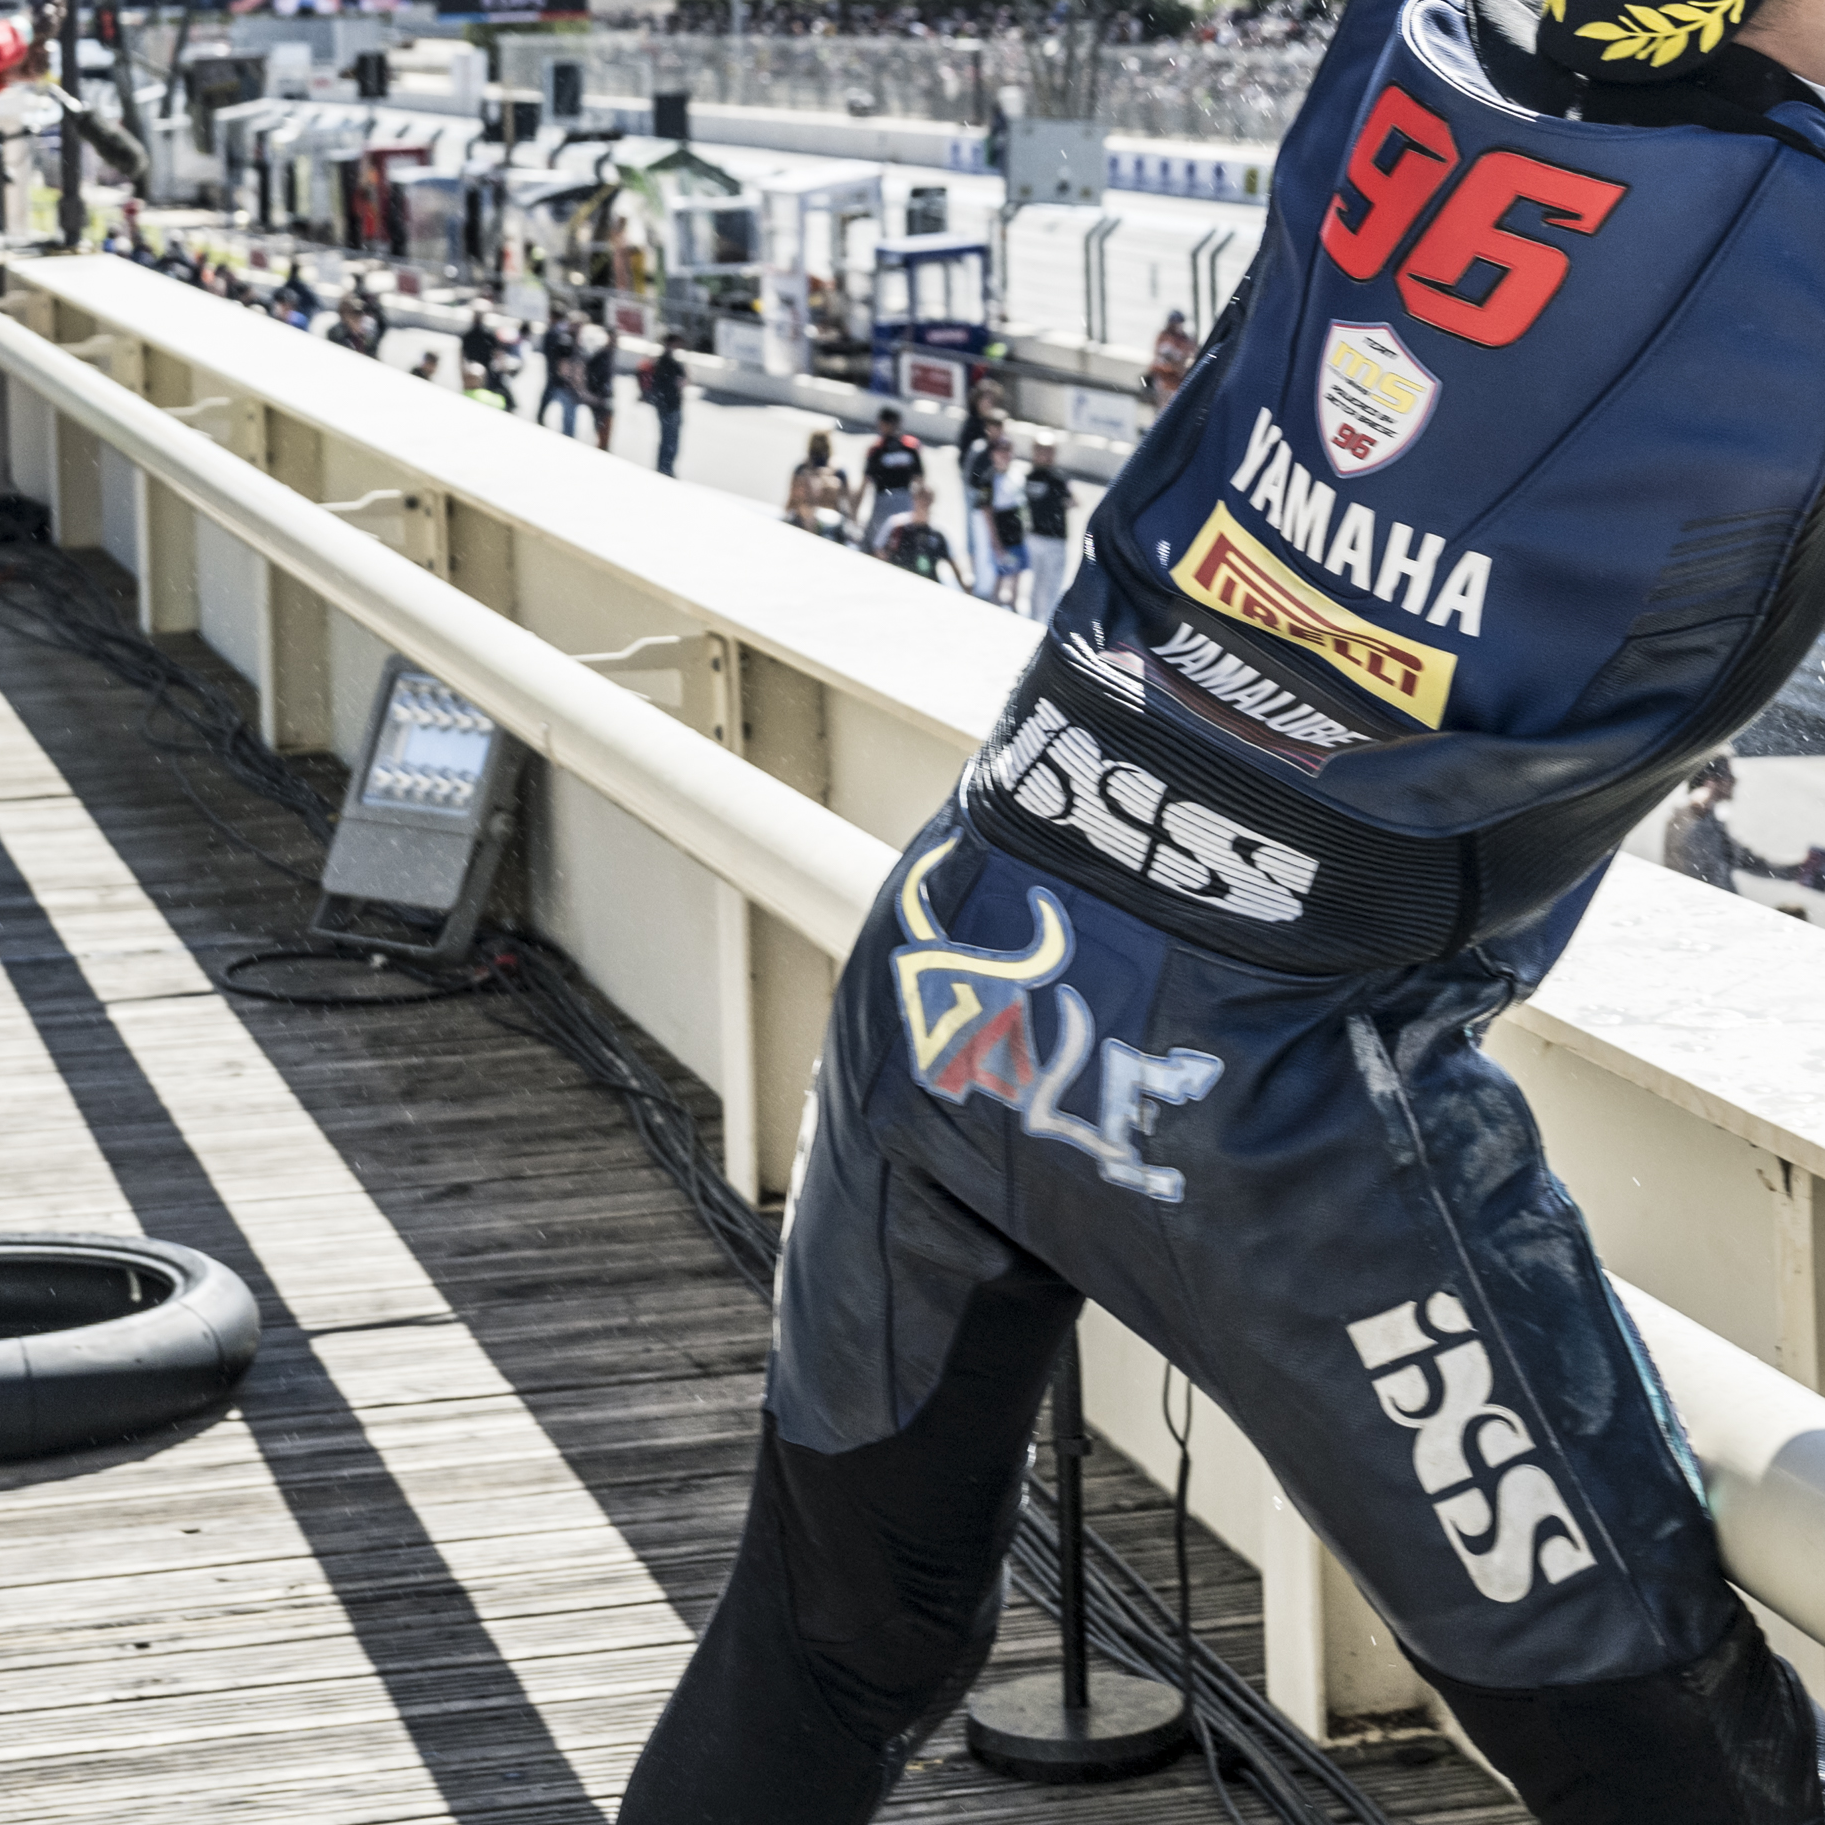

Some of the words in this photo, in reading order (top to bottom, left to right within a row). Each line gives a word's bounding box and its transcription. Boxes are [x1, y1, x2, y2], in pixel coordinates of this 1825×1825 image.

[1320, 81, 1630, 349] 96
[1230, 407, 1492, 637] YAMAHA
[1331, 423, 1378, 460] 96
[1150, 622, 1379, 748] YAMALUBE
[1193, 532, 1423, 697] PIRELLI
